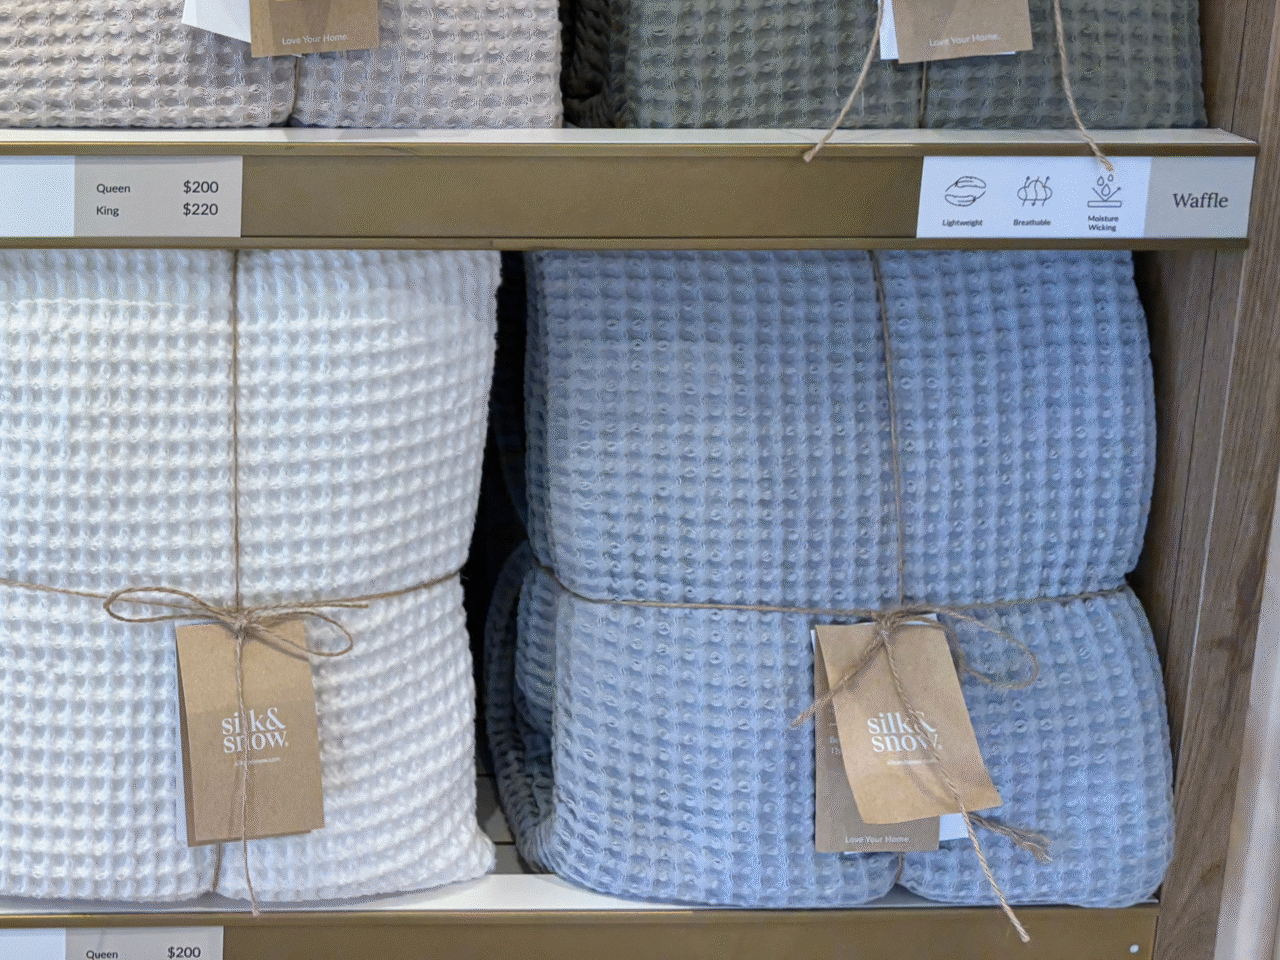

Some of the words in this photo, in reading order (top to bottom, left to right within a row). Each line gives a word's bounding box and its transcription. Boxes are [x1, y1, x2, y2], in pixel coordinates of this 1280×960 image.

[96, 183, 131, 195] Queen
[183, 180, 219, 195] $200
[1172, 191, 1229, 210] Waffle
[96, 205, 120, 218] King
[182, 201, 219, 218] $220
[1013, 218, 1051, 227] Breathable
[1087, 214, 1120, 223] Moisture
[1087, 223, 1117, 233] Wicking
[221, 707, 286, 735] sik&
[86, 949, 119, 960] Queen
[167, 947, 201, 960] $200
